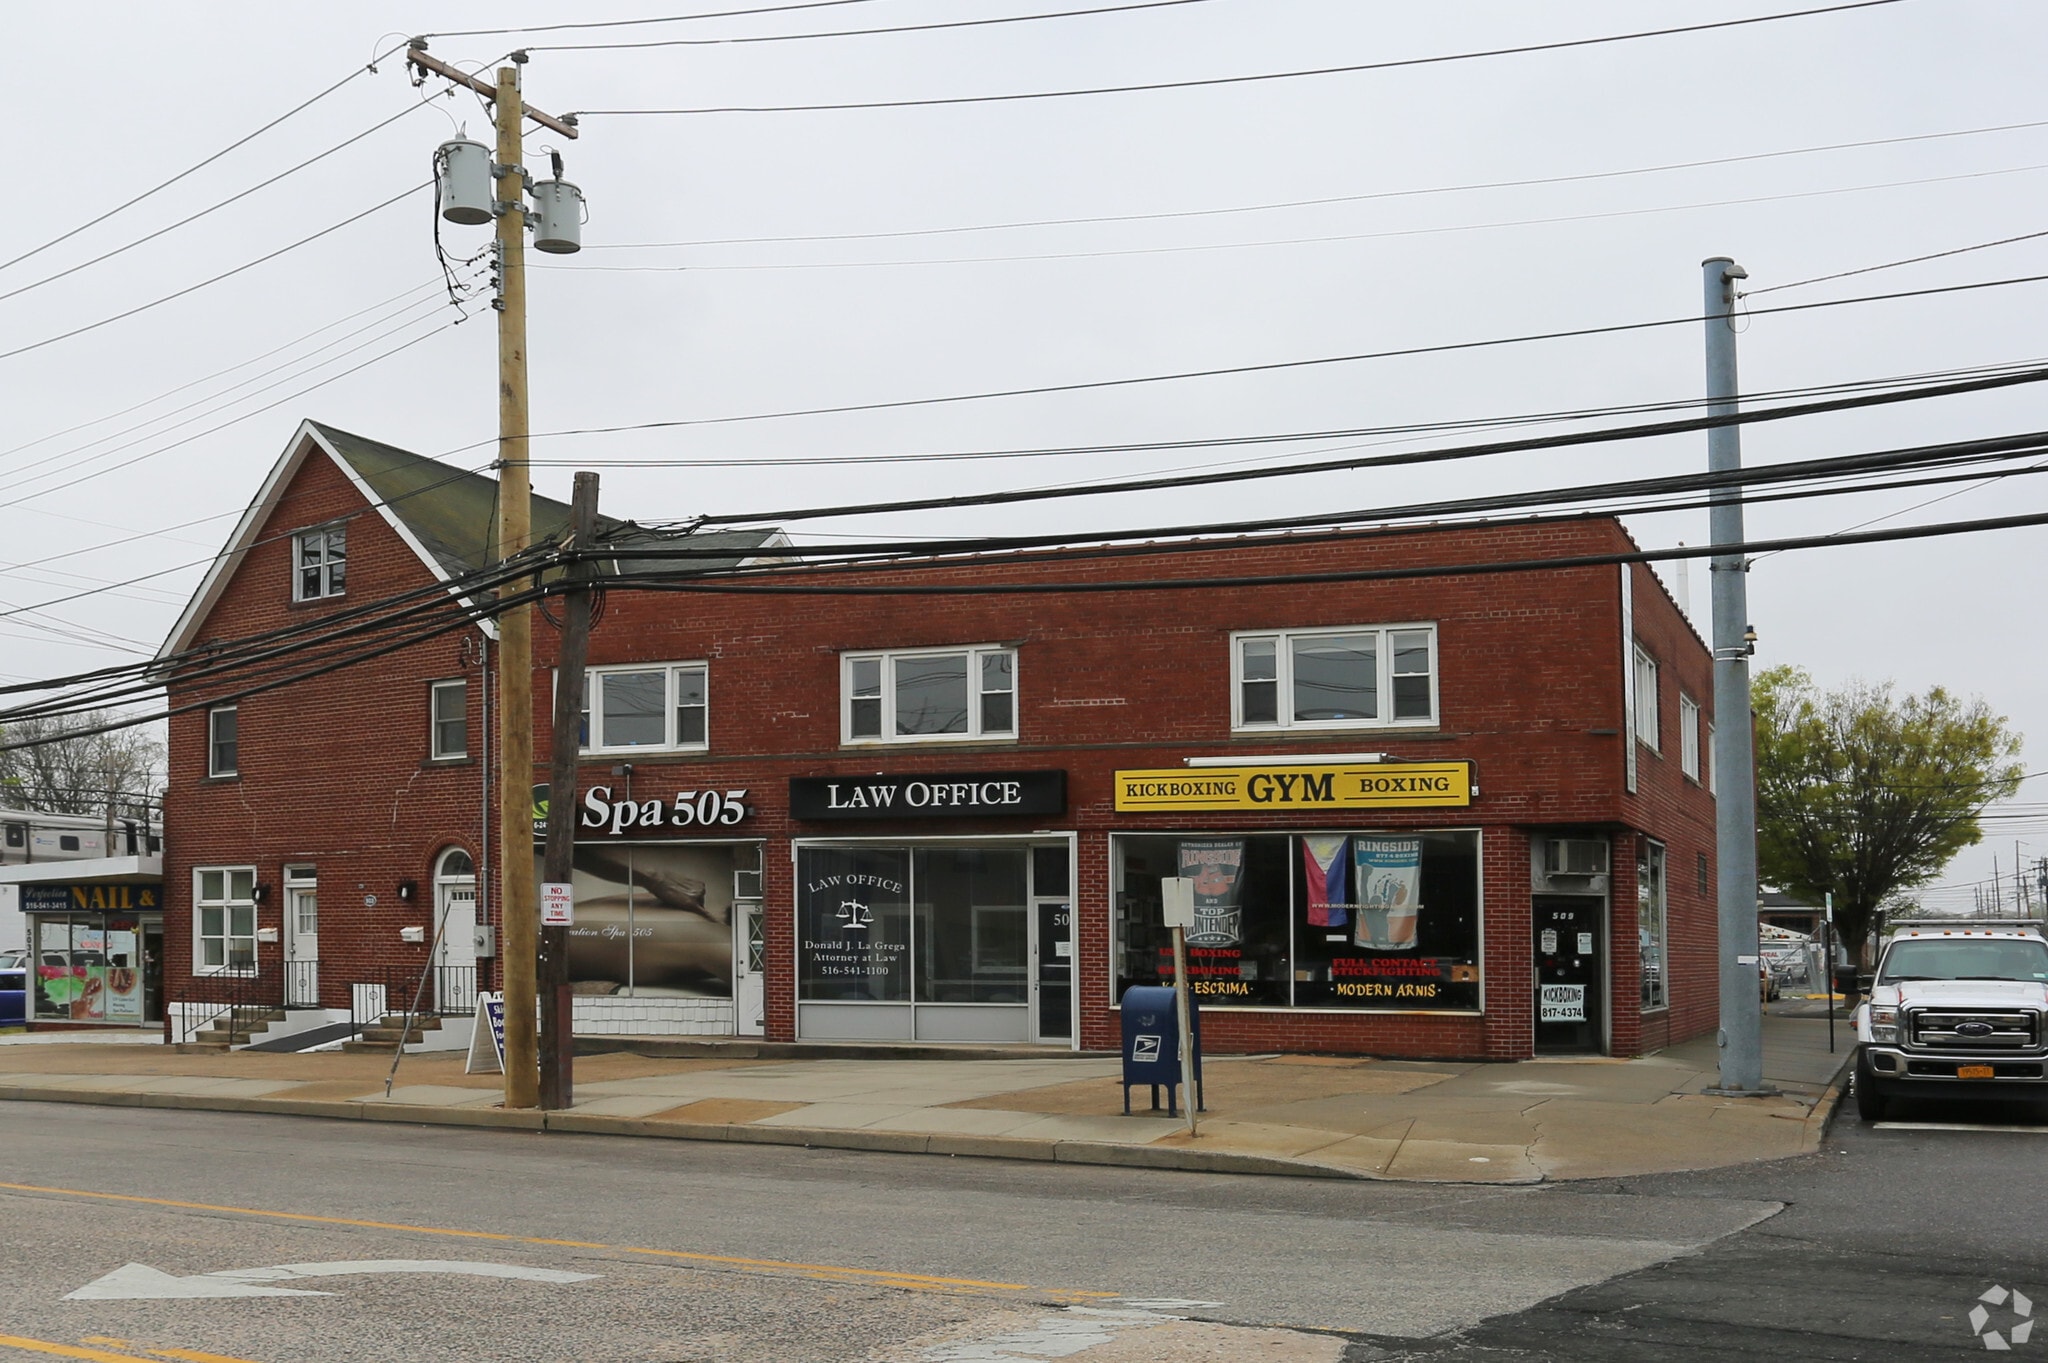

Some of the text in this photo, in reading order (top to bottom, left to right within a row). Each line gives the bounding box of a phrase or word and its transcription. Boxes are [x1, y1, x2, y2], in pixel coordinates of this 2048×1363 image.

[1126, 773, 1448, 803] KICKBOXING GYM BOXING
[828, 781, 1021, 808] LAW OFFICE
[582, 786, 747, 834] Spa 505
[1358, 840, 1419, 852] RINGSIDE
[808, 874, 903, 894] LAW OFFICE
[72, 886, 133, 908] NAIL
[139, 890, 155, 906] &
[551, 887, 563, 895] NO
[632, 928, 653, 937] 505
[805, 940, 905, 952] Donald J. La Grega
[813, 952, 858, 963] Attorney
[875, 953, 897, 962] Law
[1190, 948, 1241, 958] BOXING
[1333, 958, 1438, 968] FULL CONTACT
[821, 966, 889, 975] 516-541-1100
[1331, 966, 1441, 977] STICKFIGHTING
[1194, 981, 1249, 996] ESCRIMA
[1337, 983, 1436, 997] MODERN ARNIS
[1543, 986, 1582, 1003] KICKBOXING
